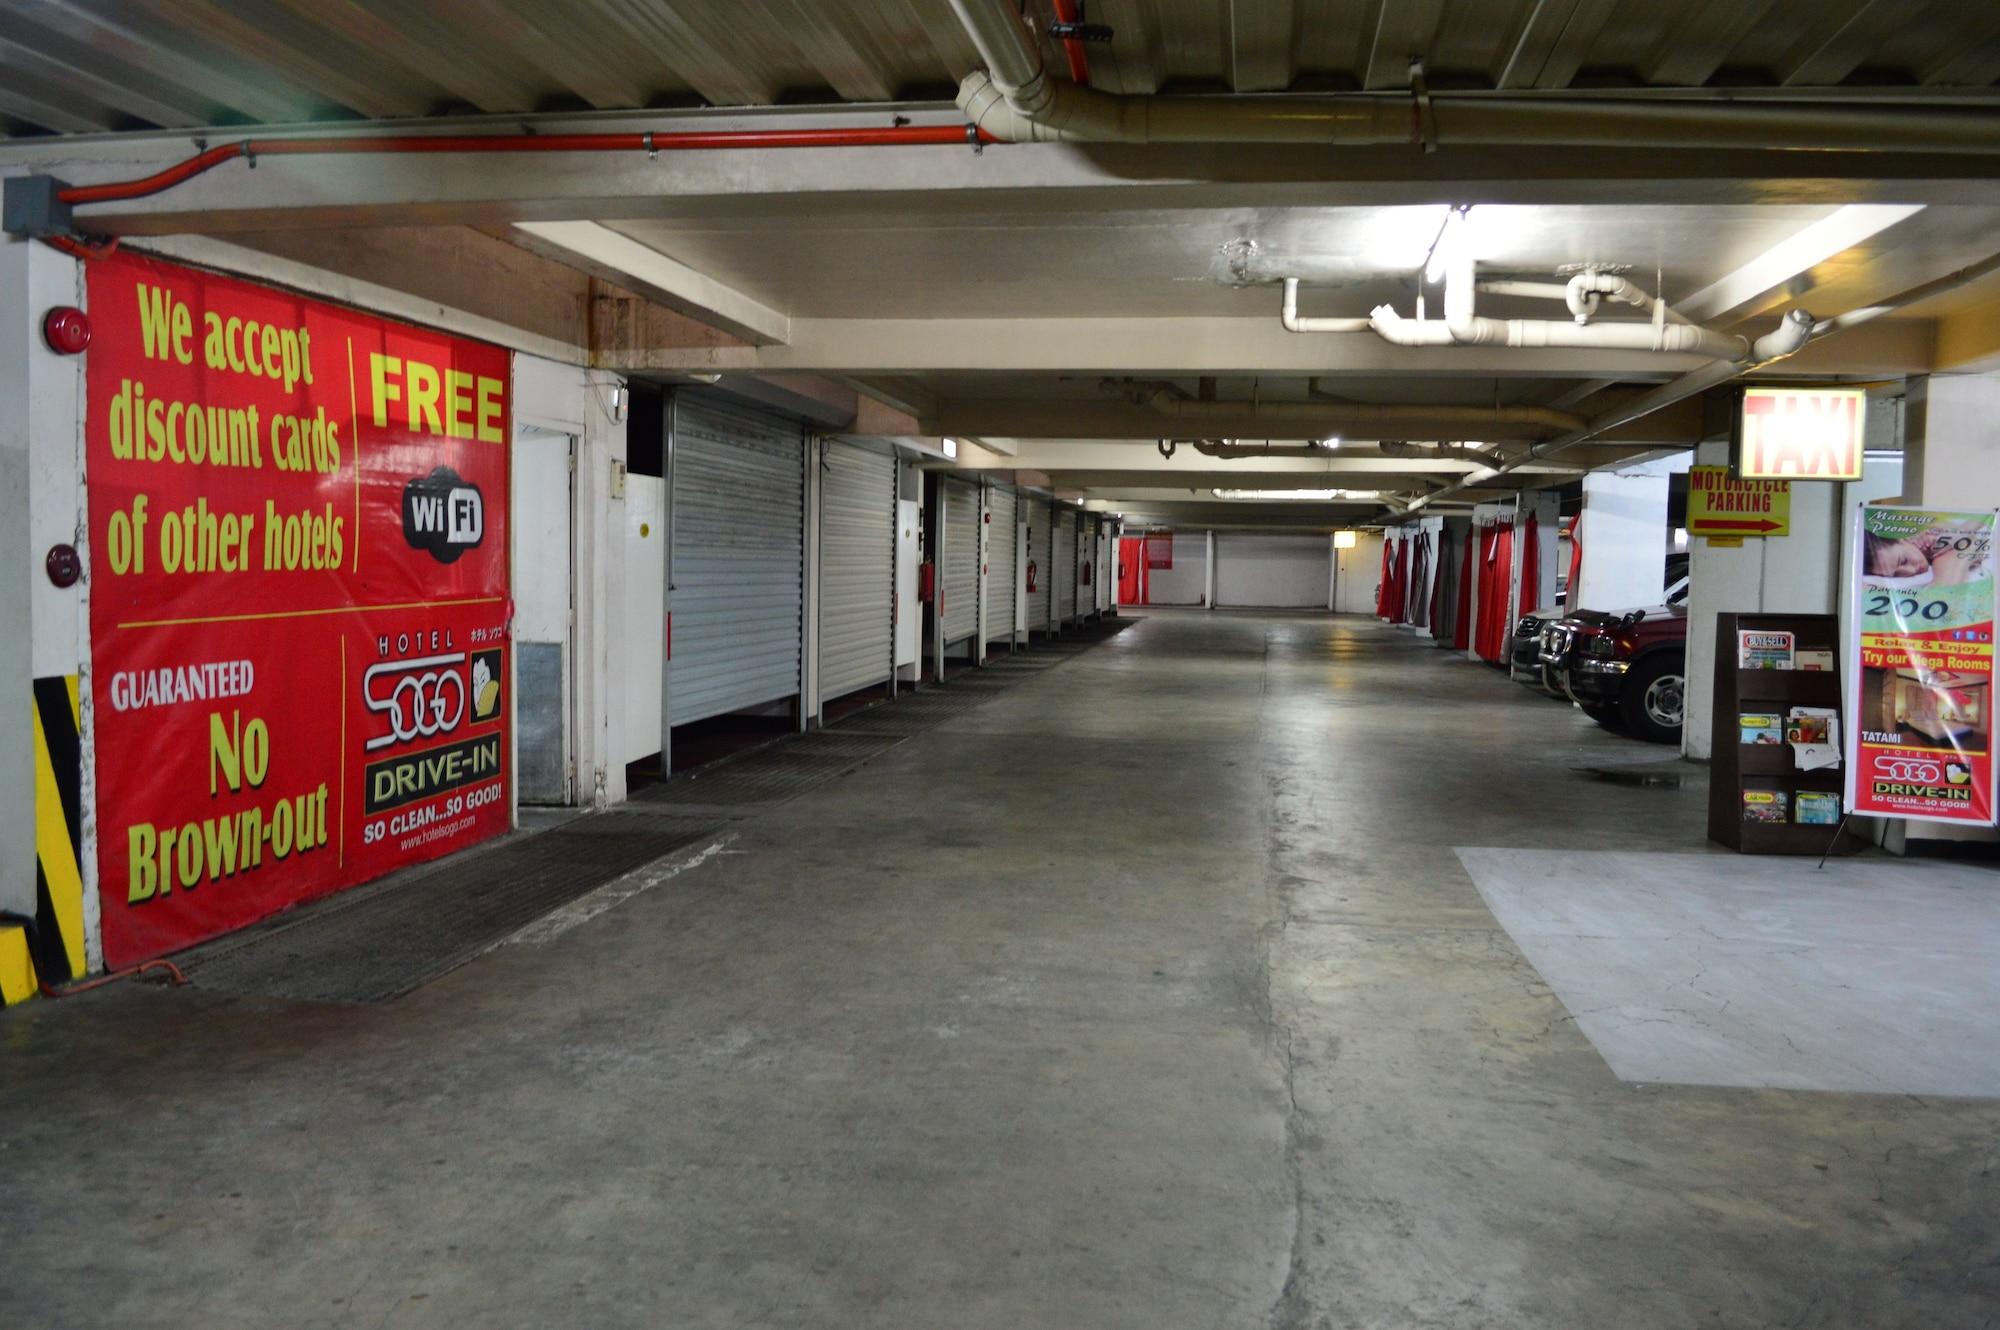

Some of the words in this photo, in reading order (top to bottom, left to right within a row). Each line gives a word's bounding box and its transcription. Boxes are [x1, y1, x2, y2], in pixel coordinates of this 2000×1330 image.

[137, 282, 193, 365] We
[204, 310, 313, 394] accept
[369, 352, 504, 444] FREE
[109, 379, 263, 469] discount
[270, 406, 341, 475] cards
[1744, 396, 1857, 475] TAXI
[1706, 492, 1771, 512] PARKING
[1868, 511, 1935, 525] Massage
[108, 494, 149, 576] of
[161, 497, 255, 576] other
[265, 500, 344, 573] hotels
[1872, 521, 1918, 534] Promo
[1932, 536, 1990, 552] 50%
[1864, 595, 1949, 620] 200
[379, 629, 453, 655] HOTEL
[1921, 640, 1933, 650] &
[1937, 642, 1981, 654] Enjoy
[1863, 650, 1883, 666] Try
[1887, 654, 1908, 664] our
[1947, 656, 1990, 671] Rooms
[111, 659, 254, 712] GUARANTEED
[364, 652, 465, 750] SOGO
[209, 709, 270, 796] No
[1862, 731, 1901, 743] TATAMI
[1873, 756, 1940, 783] SOGO
[1883, 750, 1931, 759] HOTEL
[374, 741, 497, 803] DRIVE-IN
[1875, 782, 1970, 800] DRIVE-IN
[364, 820, 386, 844] SO
[466, 783, 502, 809] GOOD!
[128, 782, 329, 904] Brown-out
[400, 814, 476, 851] www.hotelsogo.com
